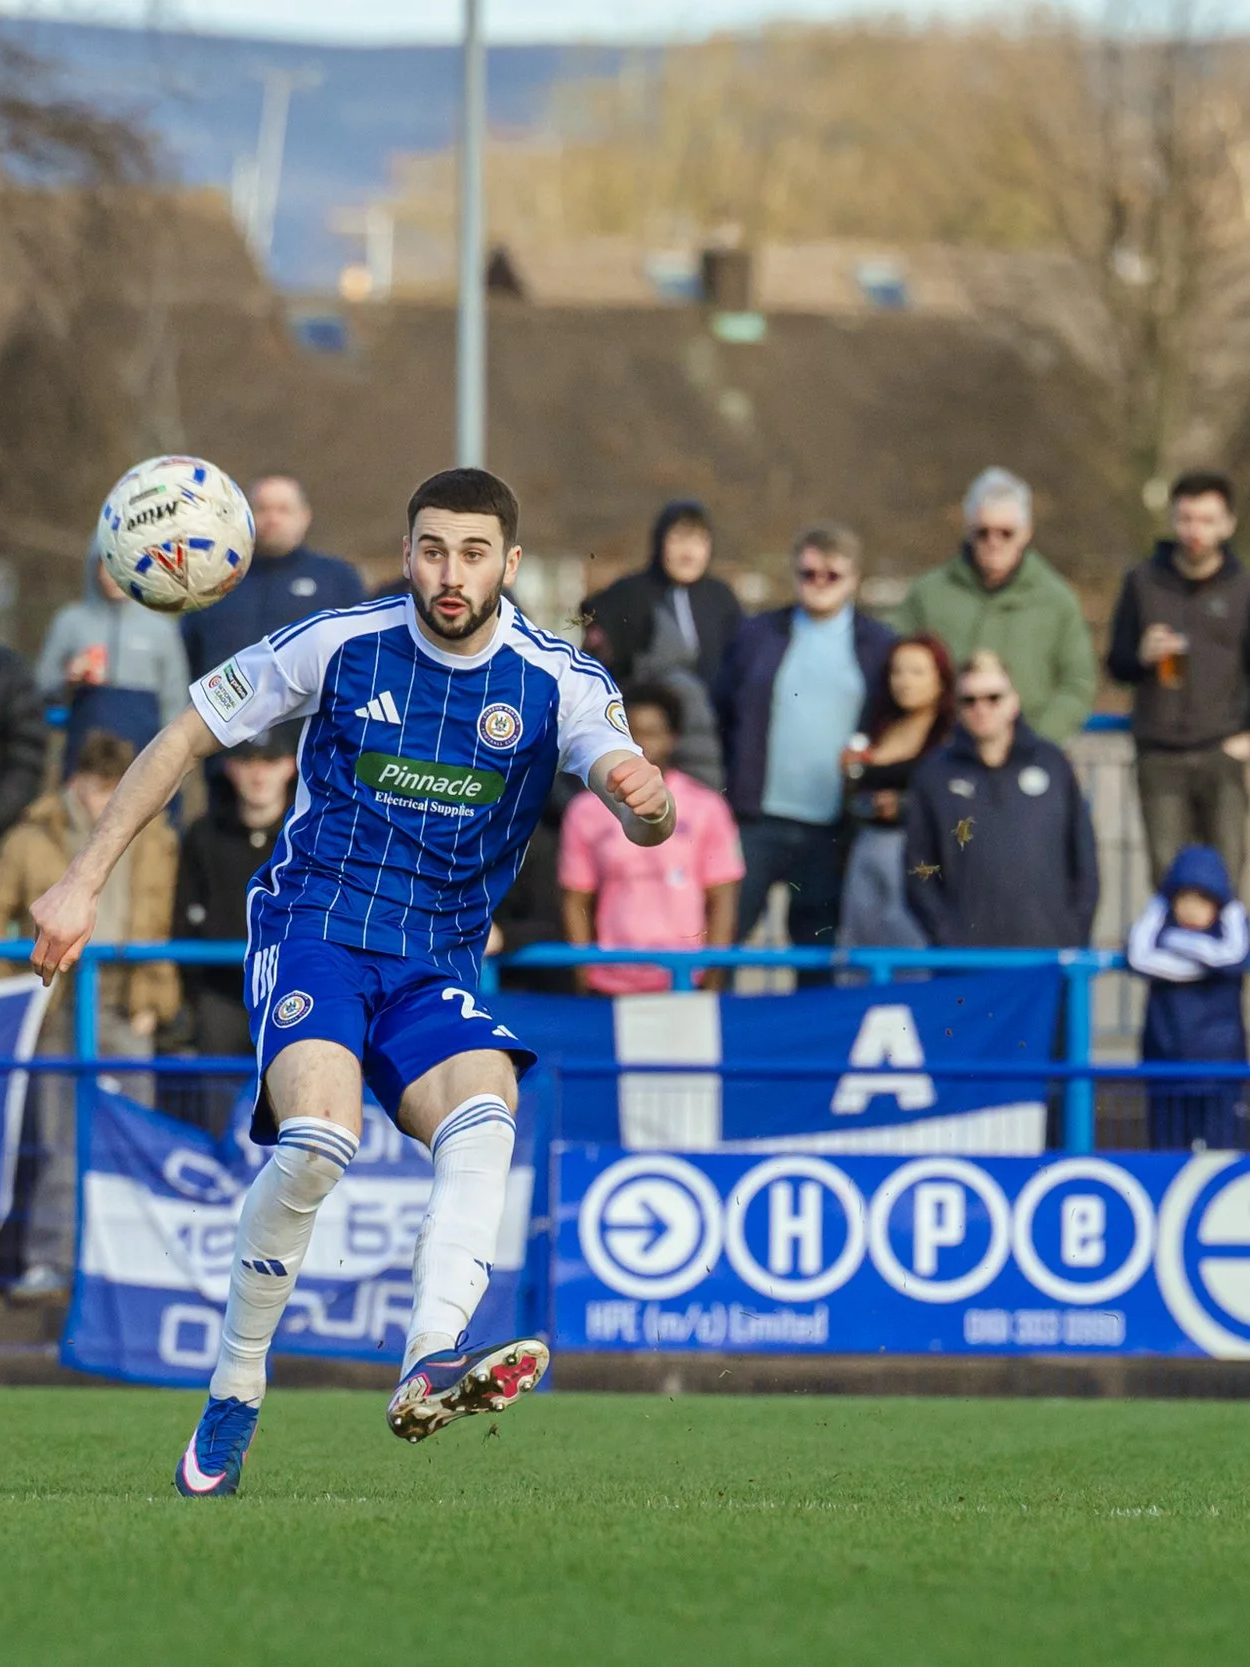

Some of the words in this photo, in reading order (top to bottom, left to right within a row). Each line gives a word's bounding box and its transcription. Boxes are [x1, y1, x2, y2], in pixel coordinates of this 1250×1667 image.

[378, 763, 482, 797] Pinnacle
[375, 790, 428, 811] Electrical
[430, 801, 474, 818] Supplies
[830, 1003, 937, 1115] A
